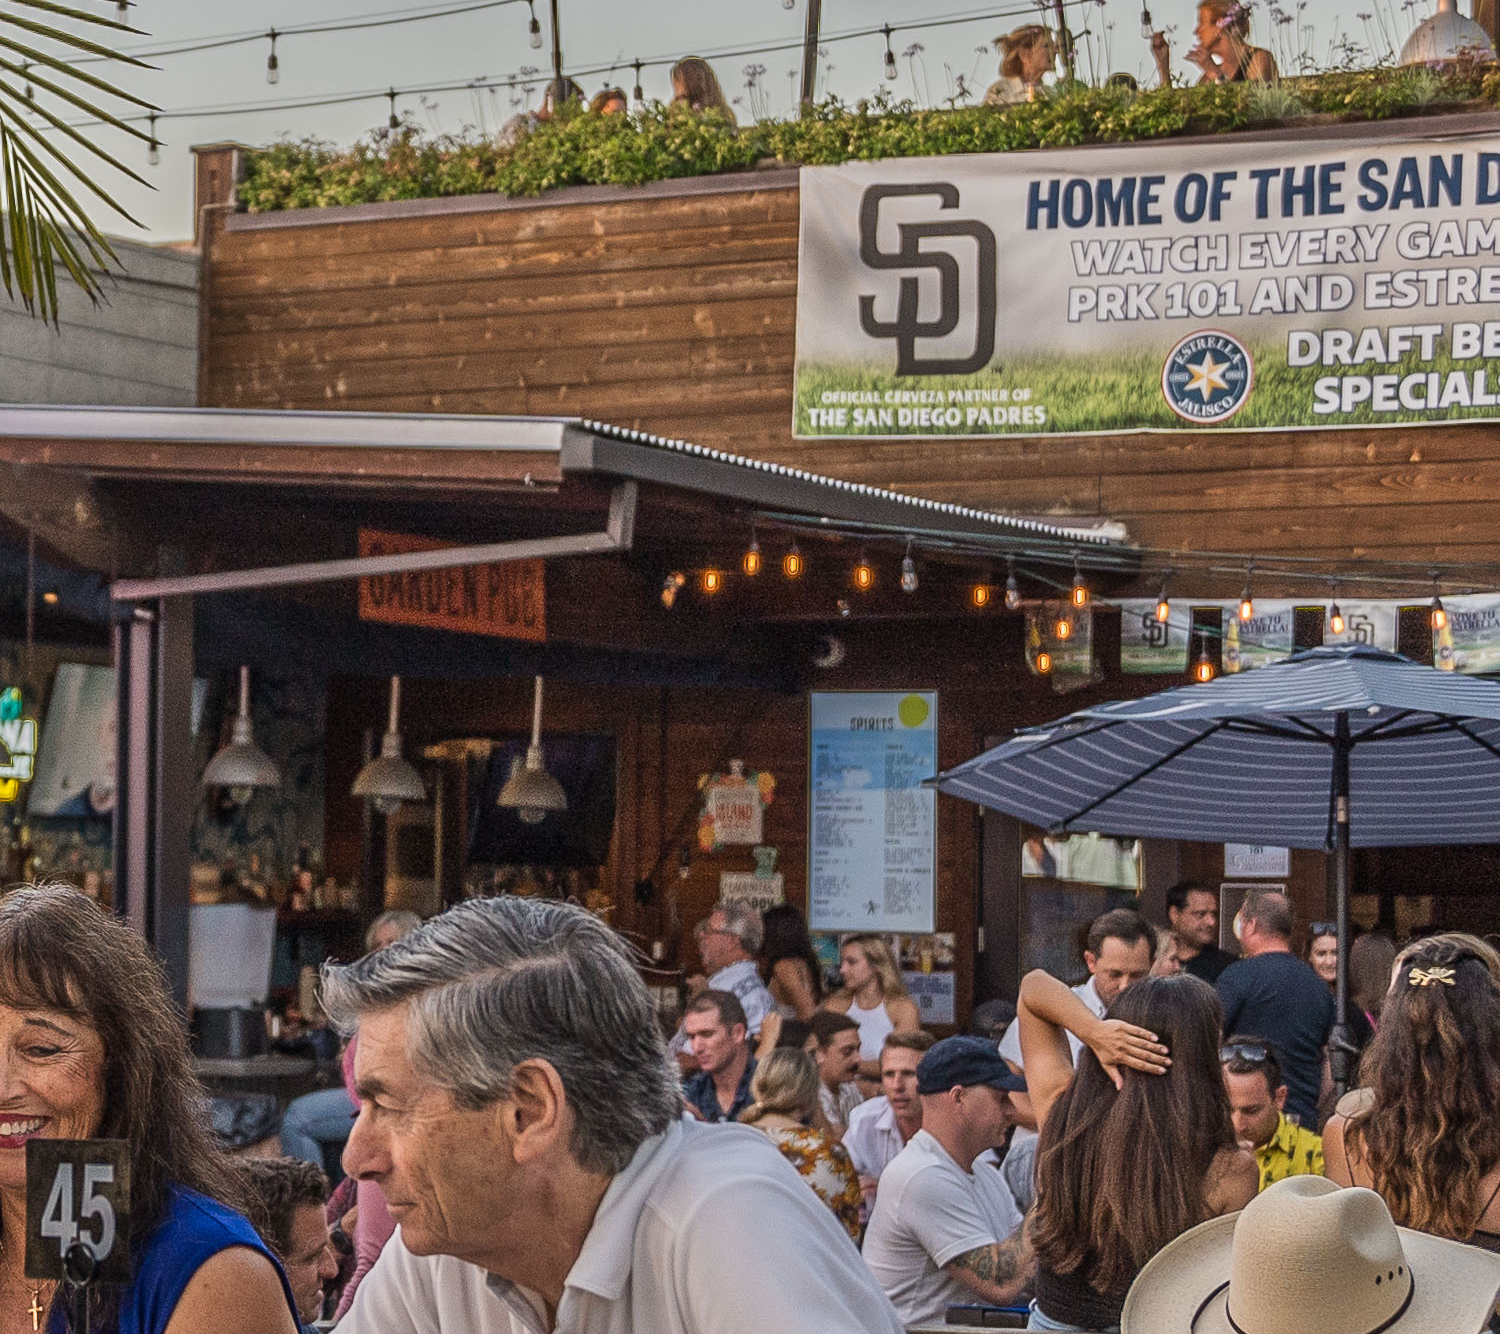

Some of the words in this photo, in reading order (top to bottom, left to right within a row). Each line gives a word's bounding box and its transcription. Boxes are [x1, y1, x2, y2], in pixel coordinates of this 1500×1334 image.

[1026, 175, 1165, 230] HOME
[1173, 171, 1238, 224] OF
[1249, 161, 1346, 219] THE
[1357, 153, 1463, 212] SAN
[1070, 234, 1229, 276] WATCH
[1239, 223, 1390, 268] EVERY
[1067, 283, 1160, 322] PRK
[1164, 279, 1242, 318] 101
[1249, 273, 1354, 315] AND
[1174, 337, 1242, 365] ESTRELLA
[1287, 323, 1443, 367] DRAFT
[821, 390, 880, 404] OFFICIAL
[885, 389, 944, 404] CERVEZA
[948, 389, 1009, 403] PARTNER
[1012, 387, 1032, 402] OF
[1178, 395, 1234, 417] JALISCO
[808, 407, 848, 427] THE
[852, 408, 894, 427] SAN
[898, 407, 962, 427] DIEGO
[966, 404, 1047, 426] PADRES
[850, 716, 894, 732] SPIRITS
[41, 1162, 116, 1261] 45
